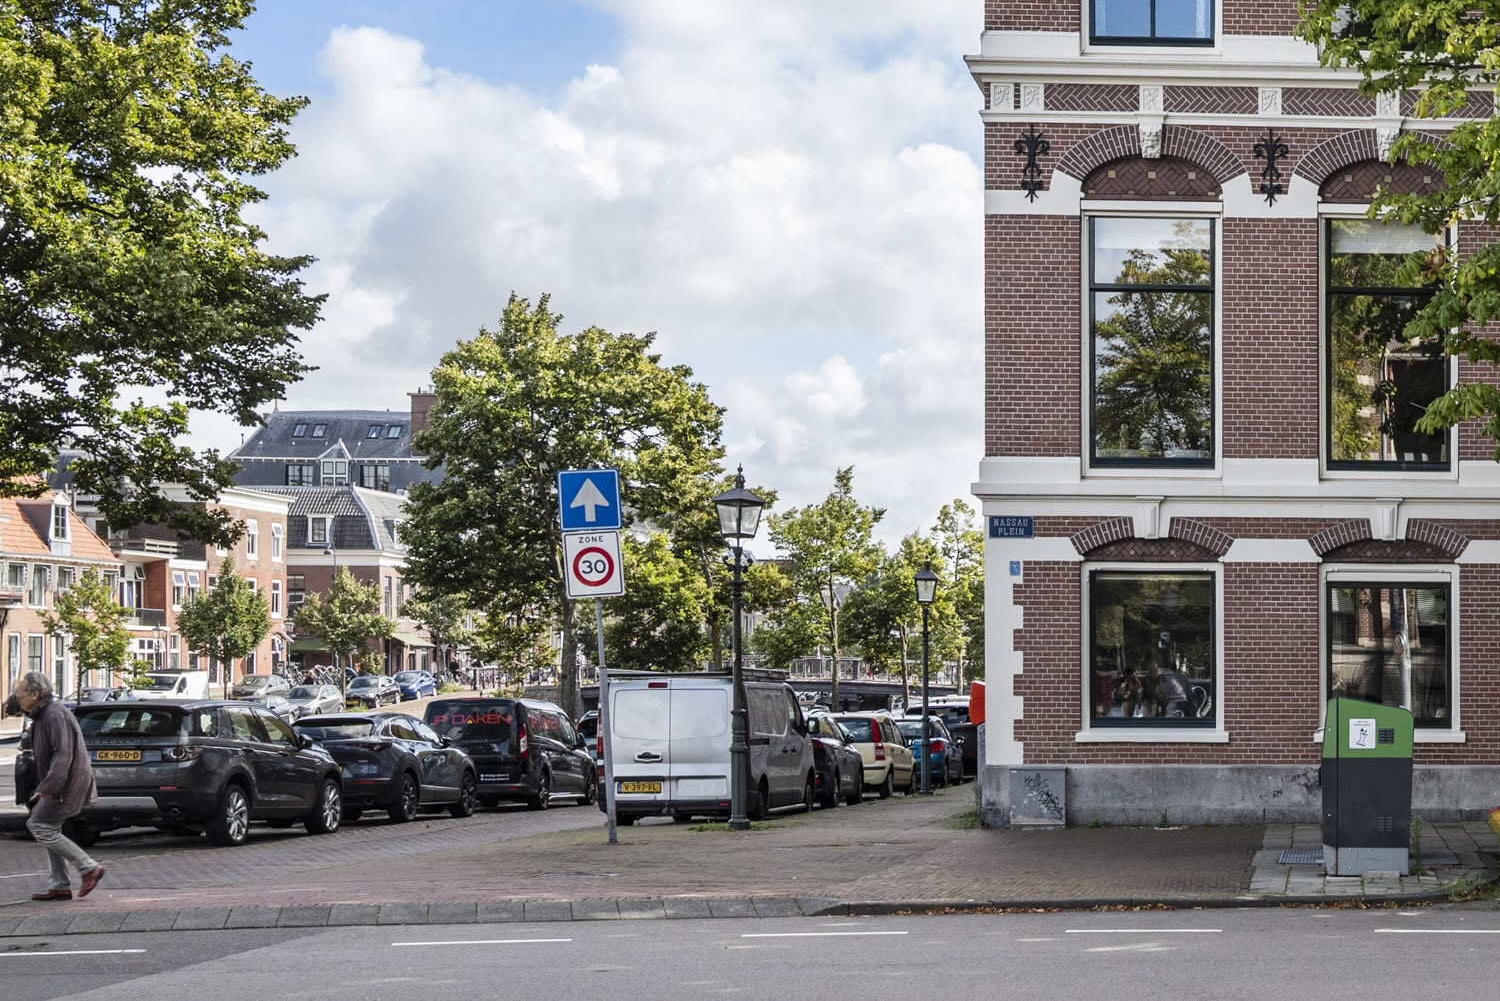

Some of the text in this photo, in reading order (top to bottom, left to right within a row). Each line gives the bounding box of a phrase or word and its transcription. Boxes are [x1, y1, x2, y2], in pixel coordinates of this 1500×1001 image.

[993, 518, 1028, 527] NASSAU
[998, 527, 1025, 536] PLEIN
[578, 535, 604, 544] ZONE
[581, 559, 606, 574] 30
[430, 713, 512, 726] JP DAKEN
[98, 751, 139, 759] GK-960-D
[624, 783, 658, 791] V-397-FL
